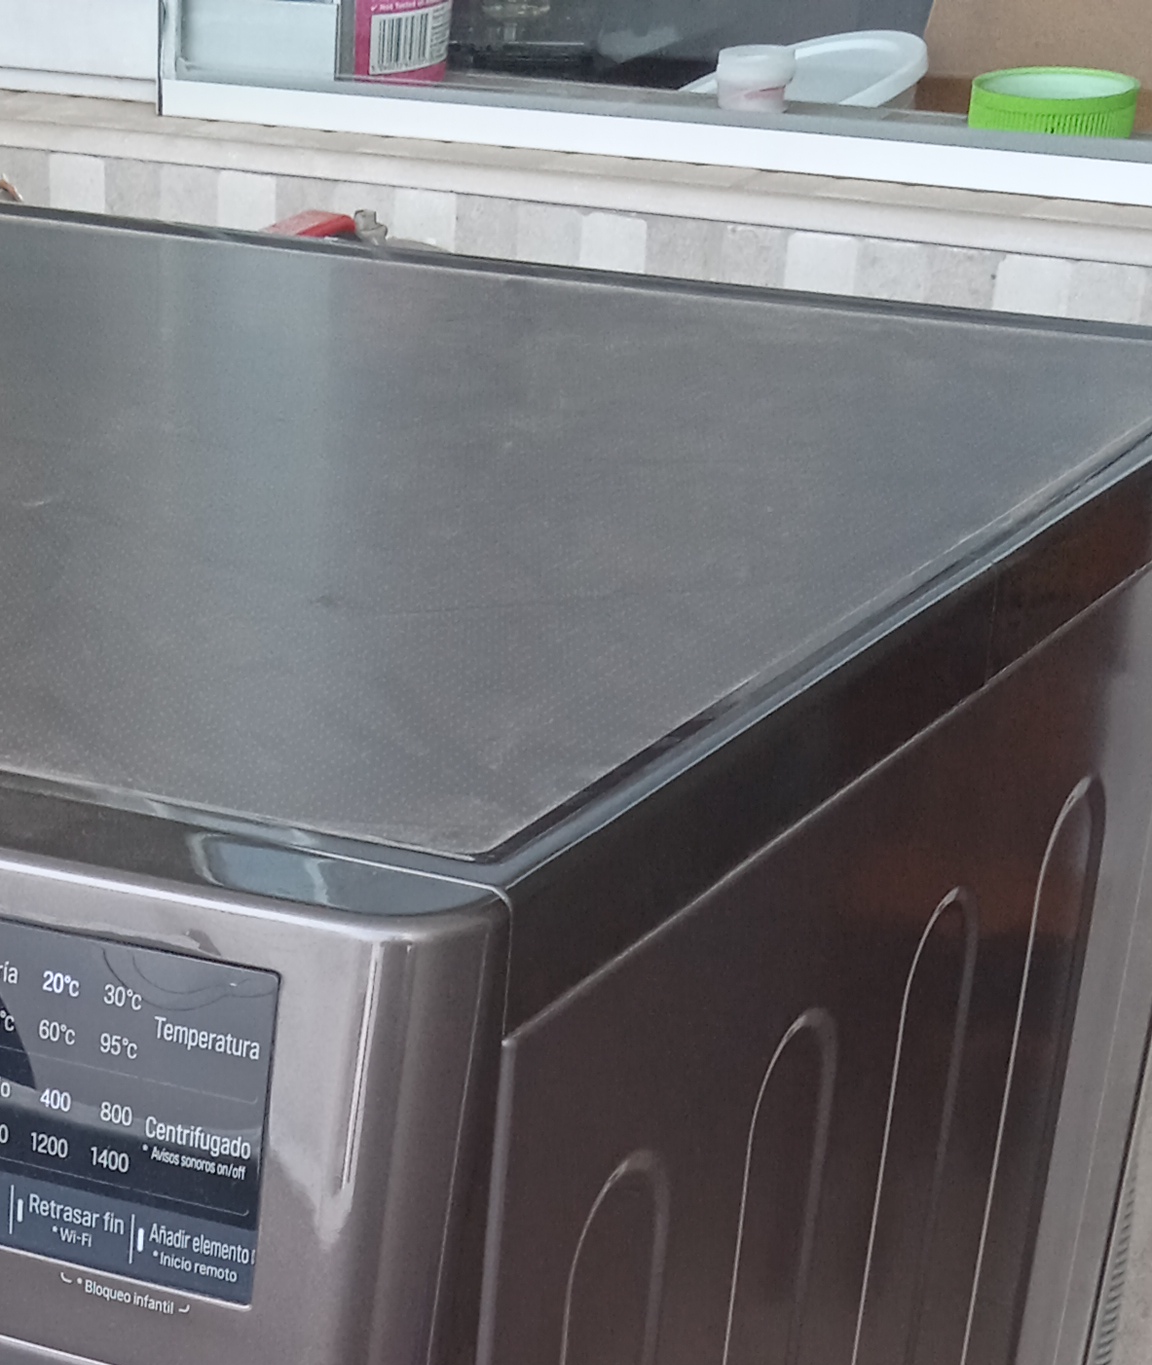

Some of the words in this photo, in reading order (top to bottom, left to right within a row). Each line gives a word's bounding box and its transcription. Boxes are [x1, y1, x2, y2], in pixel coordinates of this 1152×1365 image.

[154, 1016, 261, 1060] Temperatura
[40, 1088, 71, 1112] 400
[100, 1101, 133, 1126] 800
[31, 1132, 69, 1158] 1200
[90, 1146, 130, 1173] 1400
[145, 1116, 251, 1161] Centrifugado
[150, 1148, 180, 1167] Avisos
[180, 1155, 216, 1174] sonoros
[216, 1162, 247, 1181] on/off
[29, 1193, 100, 1229] Retrasar
[103, 1212, 125, 1236] fin
[60, 1227, 93, 1248] Wi-Fi
[149, 1223, 189, 1250] Añadir
[192, 1234, 249, 1264] elemento
[160, 1251, 192, 1273] Inicio
[194, 1262, 238, 1284] remoto
[84, 1278, 131, 1304] Bloqueo
[133, 1292, 174, 1315] infantil
